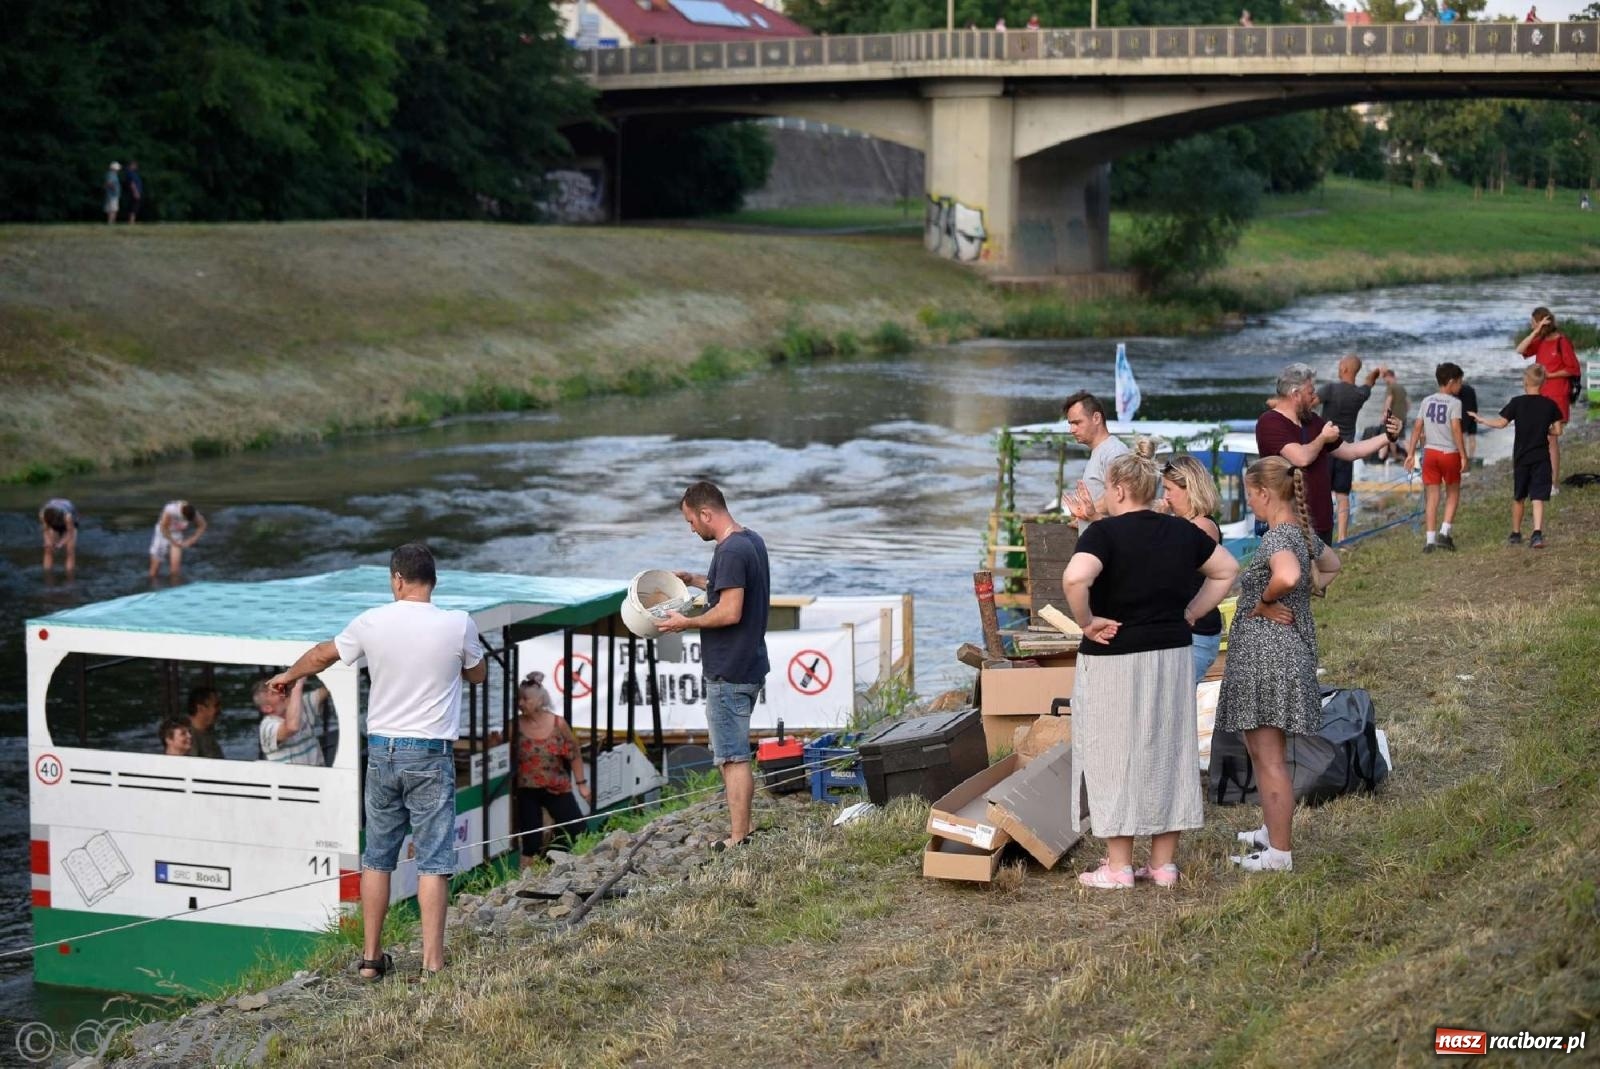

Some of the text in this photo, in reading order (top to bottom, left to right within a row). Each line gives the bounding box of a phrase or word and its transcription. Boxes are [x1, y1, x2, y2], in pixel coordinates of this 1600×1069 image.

[1426, 403, 1448, 424] 48
[41, 763, 58, 777] 40
[308, 856, 331, 876] 11
[195, 871, 223, 883] Book
